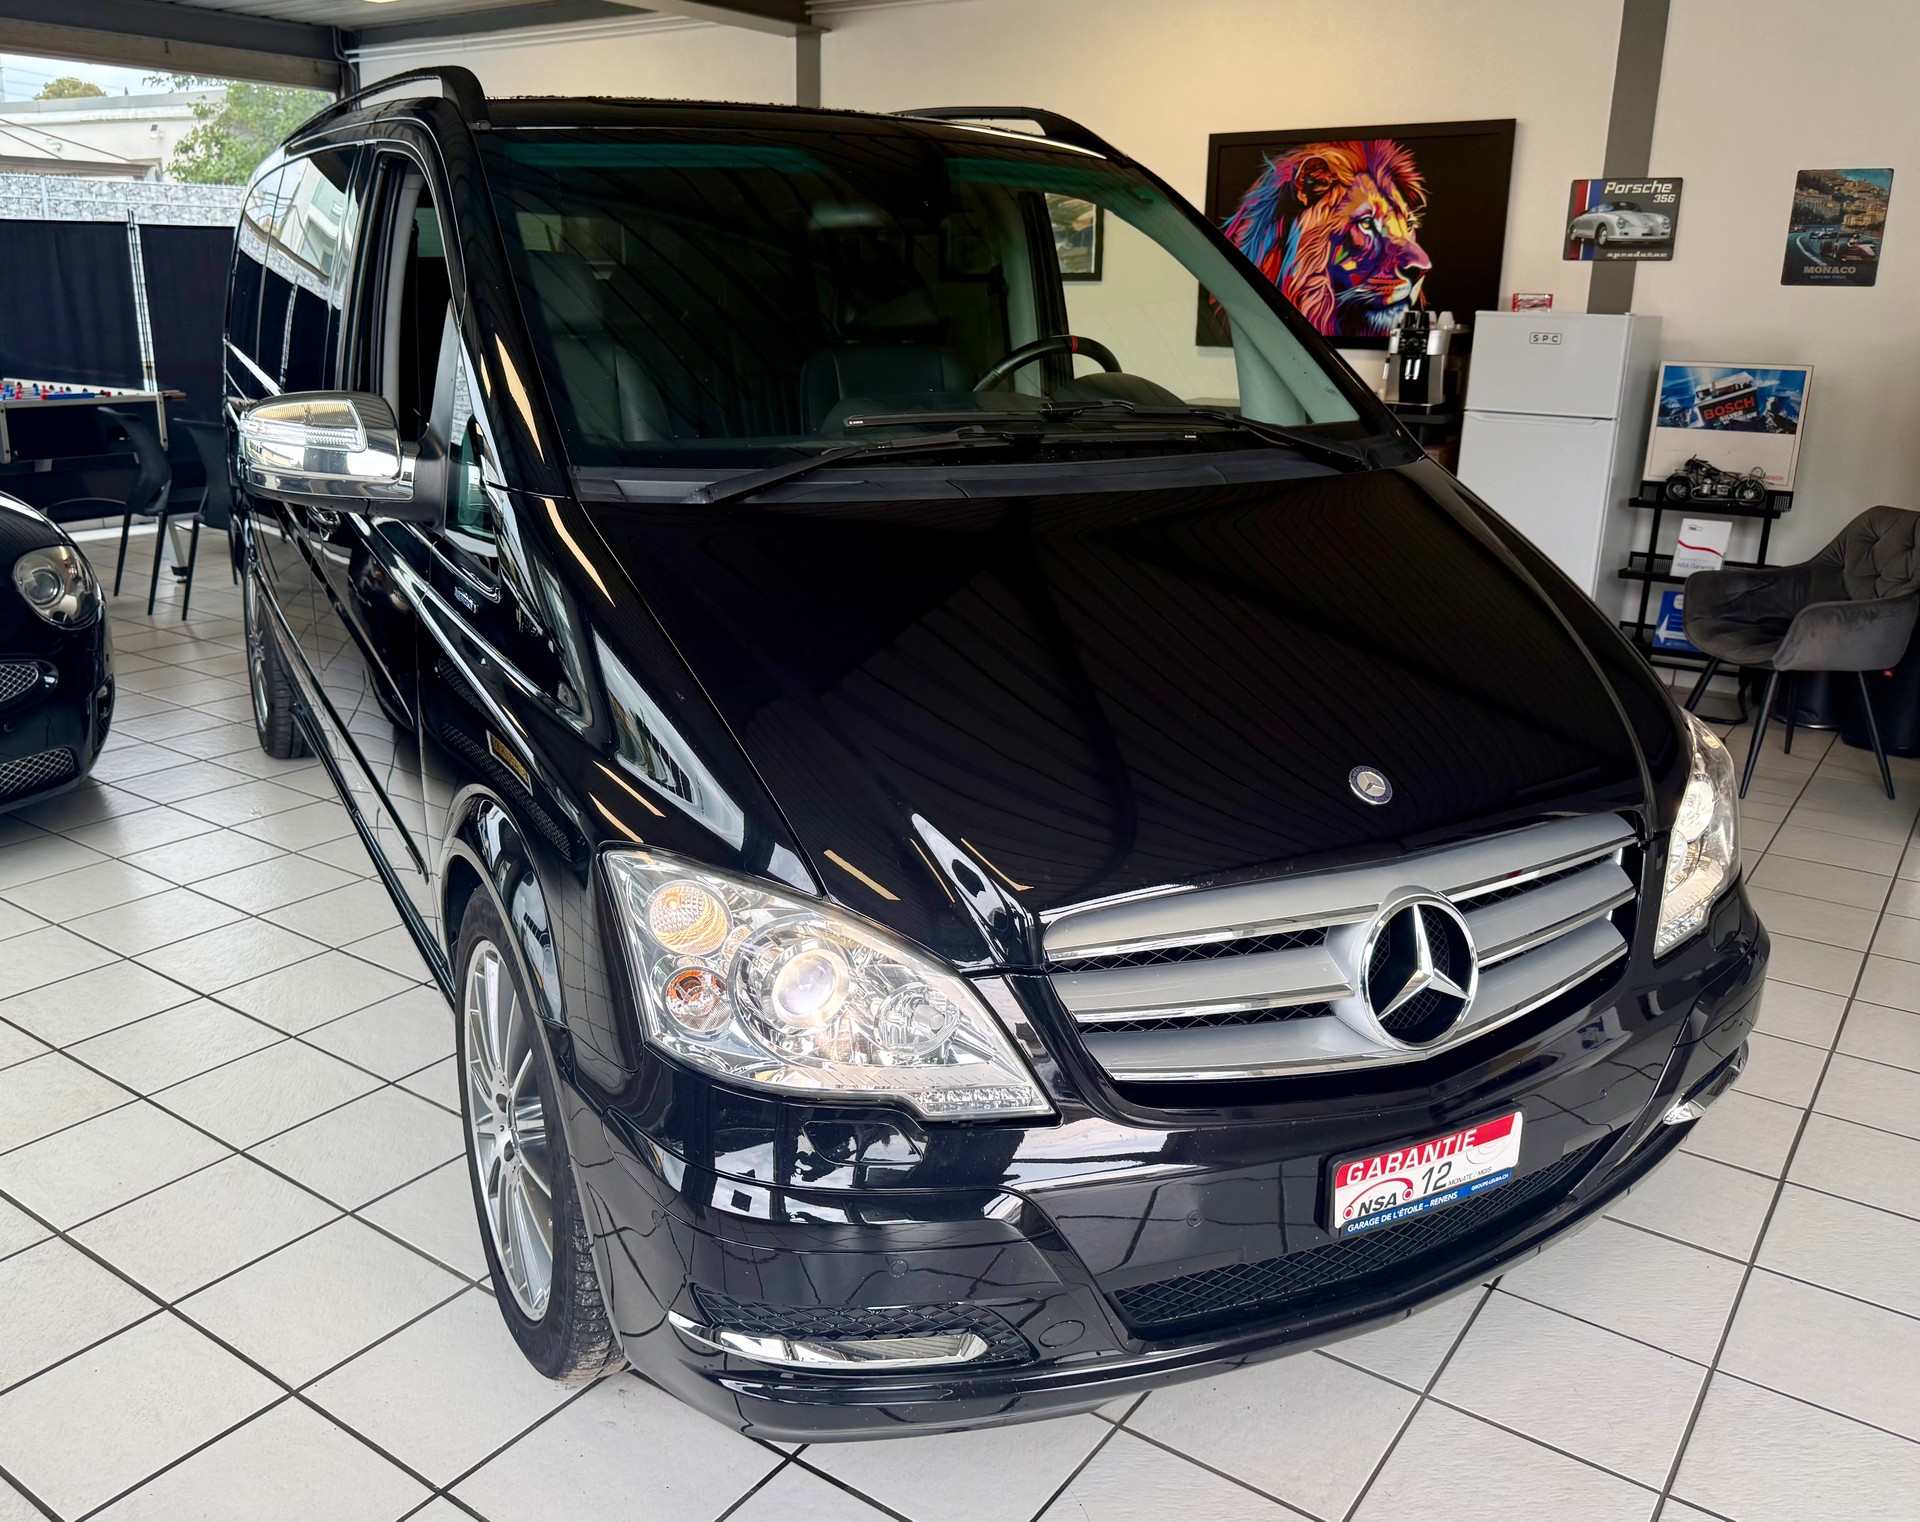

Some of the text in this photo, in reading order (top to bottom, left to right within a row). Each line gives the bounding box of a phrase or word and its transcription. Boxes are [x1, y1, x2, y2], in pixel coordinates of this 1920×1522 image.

[1604, 180, 1673, 194] Porsche
[1653, 194, 1676, 203] 356
[1803, 266, 1857, 274] MONACO
[1703, 396, 1755, 421] BOSCH
[1346, 1129, 1478, 1186] GARANTIE
[1421, 1161, 1453, 1195] 12
[1347, 1217, 1380, 1232] GARAGE
[1381, 1213, 1391, 1223] DE
[1393, 1203, 1423, 1218] L'ÉTOILE
[1430, 1191, 1458, 1207] RENENS
[1358, 1192, 1398, 1217] NSA
